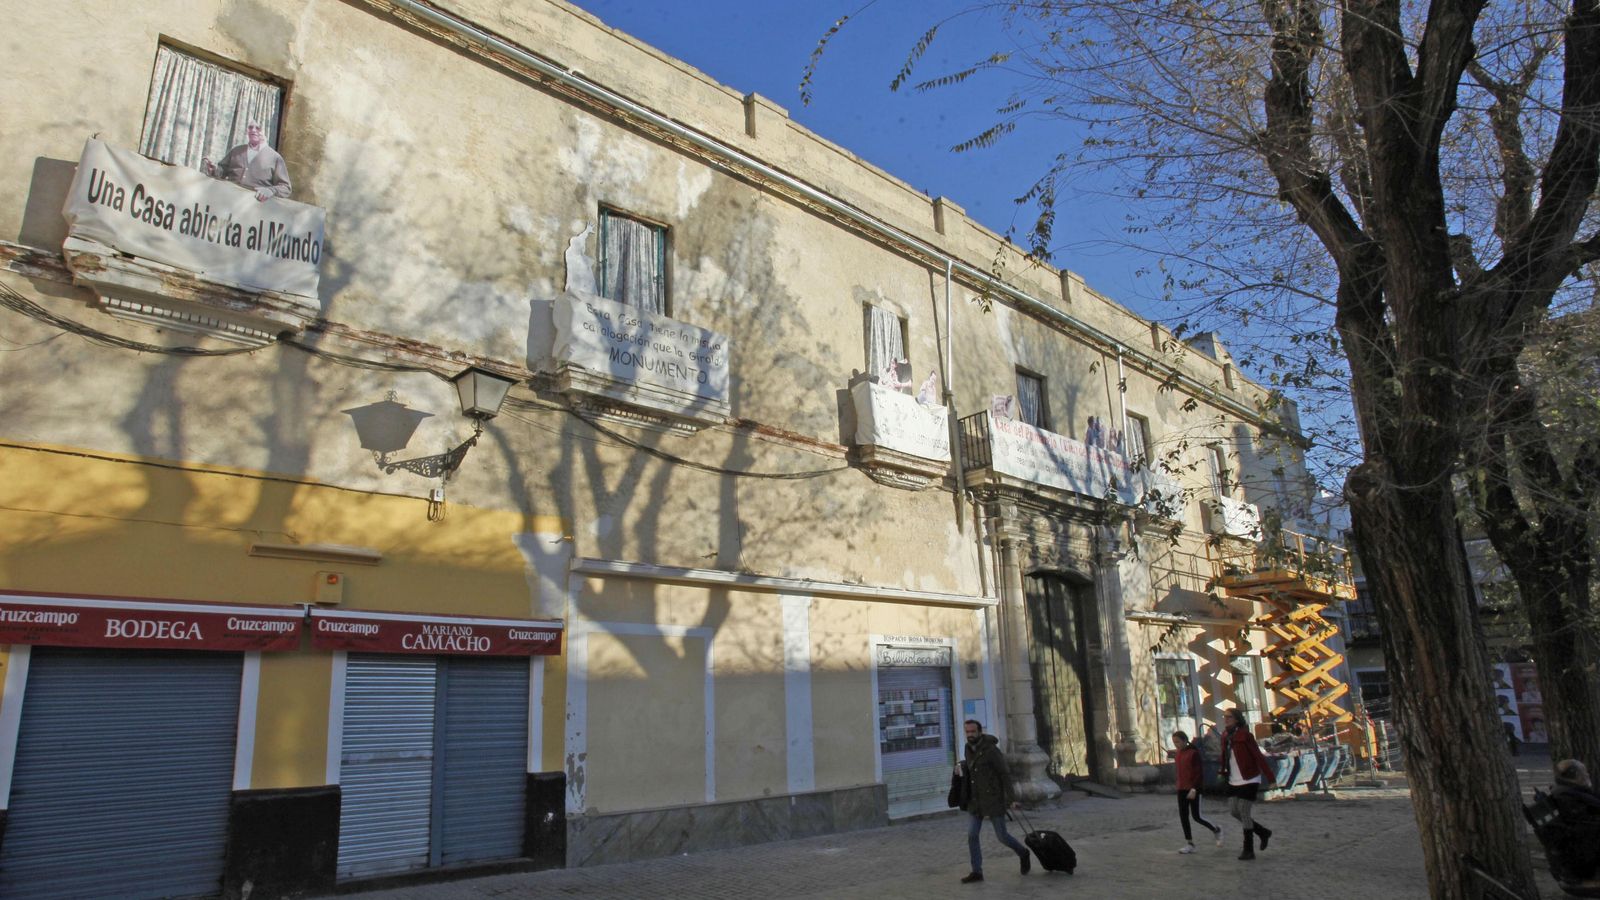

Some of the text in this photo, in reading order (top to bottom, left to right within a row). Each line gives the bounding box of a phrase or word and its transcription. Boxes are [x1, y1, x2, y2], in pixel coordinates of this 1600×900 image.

[87, 168, 320, 265] Una Casa abierta al Mundo
[618, 313, 643, 329] Casa
[649, 320, 676, 338] tiene
[679, 329, 689, 342] la
[653, 341, 672, 355] que
[674, 345, 684, 358] la
[609, 347, 708, 385] MONUMENTO
[105, 619, 203, 640] BODEGA
[227, 617, 295, 634] Cruzcampo
[318, 619, 379, 636] Cruzcampo
[422, 624, 473, 636] MARIANO
[402, 633, 491, 652] CAMACHO
[508, 629, 557, 643] Cruzcampo
